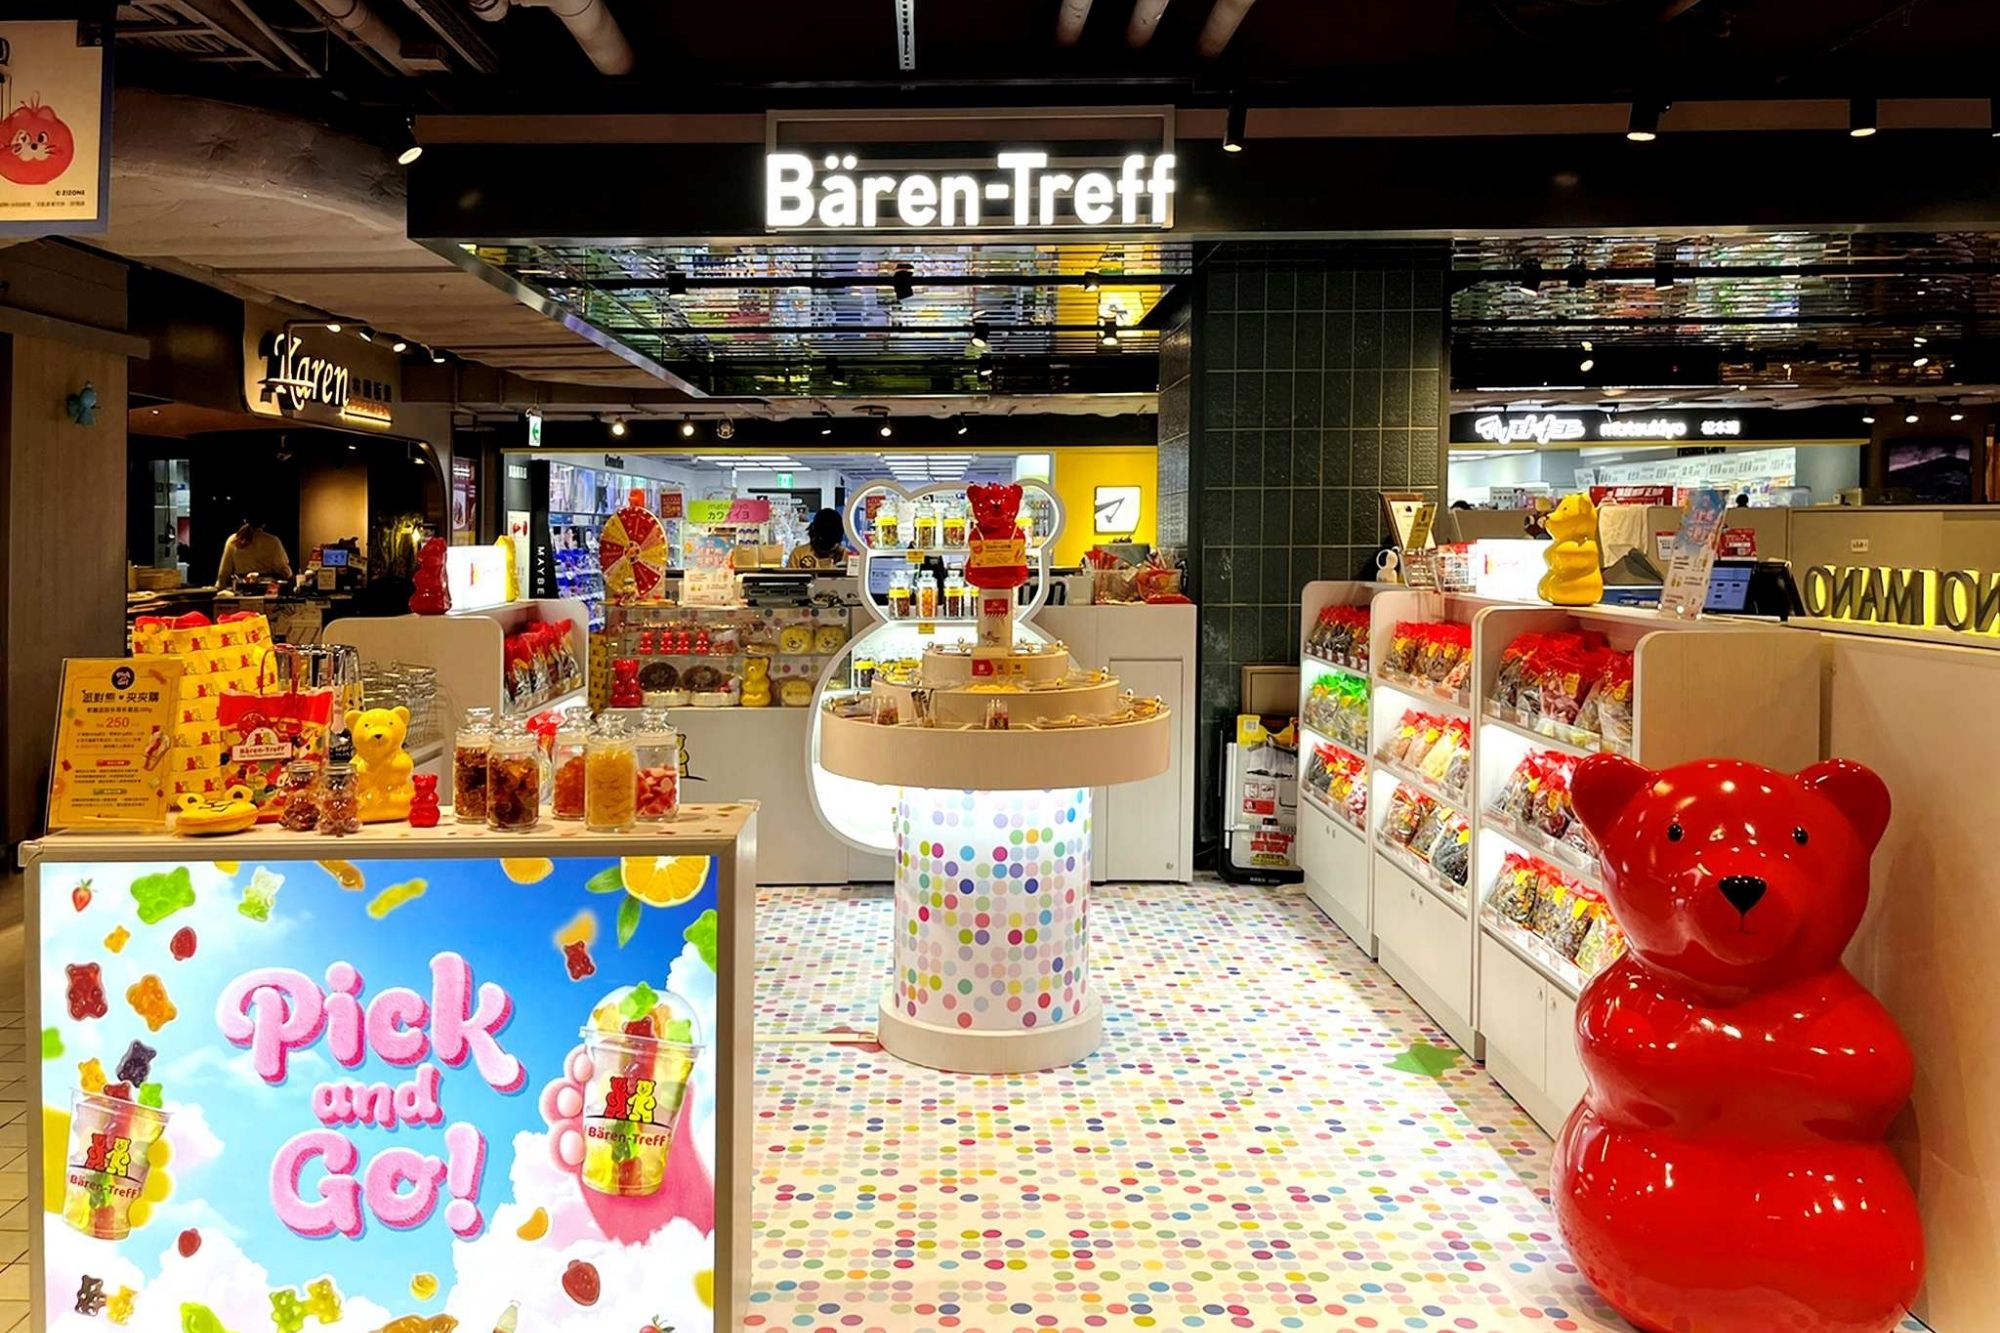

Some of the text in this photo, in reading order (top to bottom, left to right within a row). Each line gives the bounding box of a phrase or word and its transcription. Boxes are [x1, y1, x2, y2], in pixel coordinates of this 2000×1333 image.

[766, 152, 1176, 228] Bären-Treff
[268, 333, 349, 410] Karen
[106, 717, 130, 728] 250
[215, 951, 527, 1094] Pick
[312, 1064, 443, 1128] and
[588, 1126, 666, 1146] Bären-Treff
[70, 1174, 137, 1198] Bären-Treff
[270, 1121, 486, 1240] Go!
